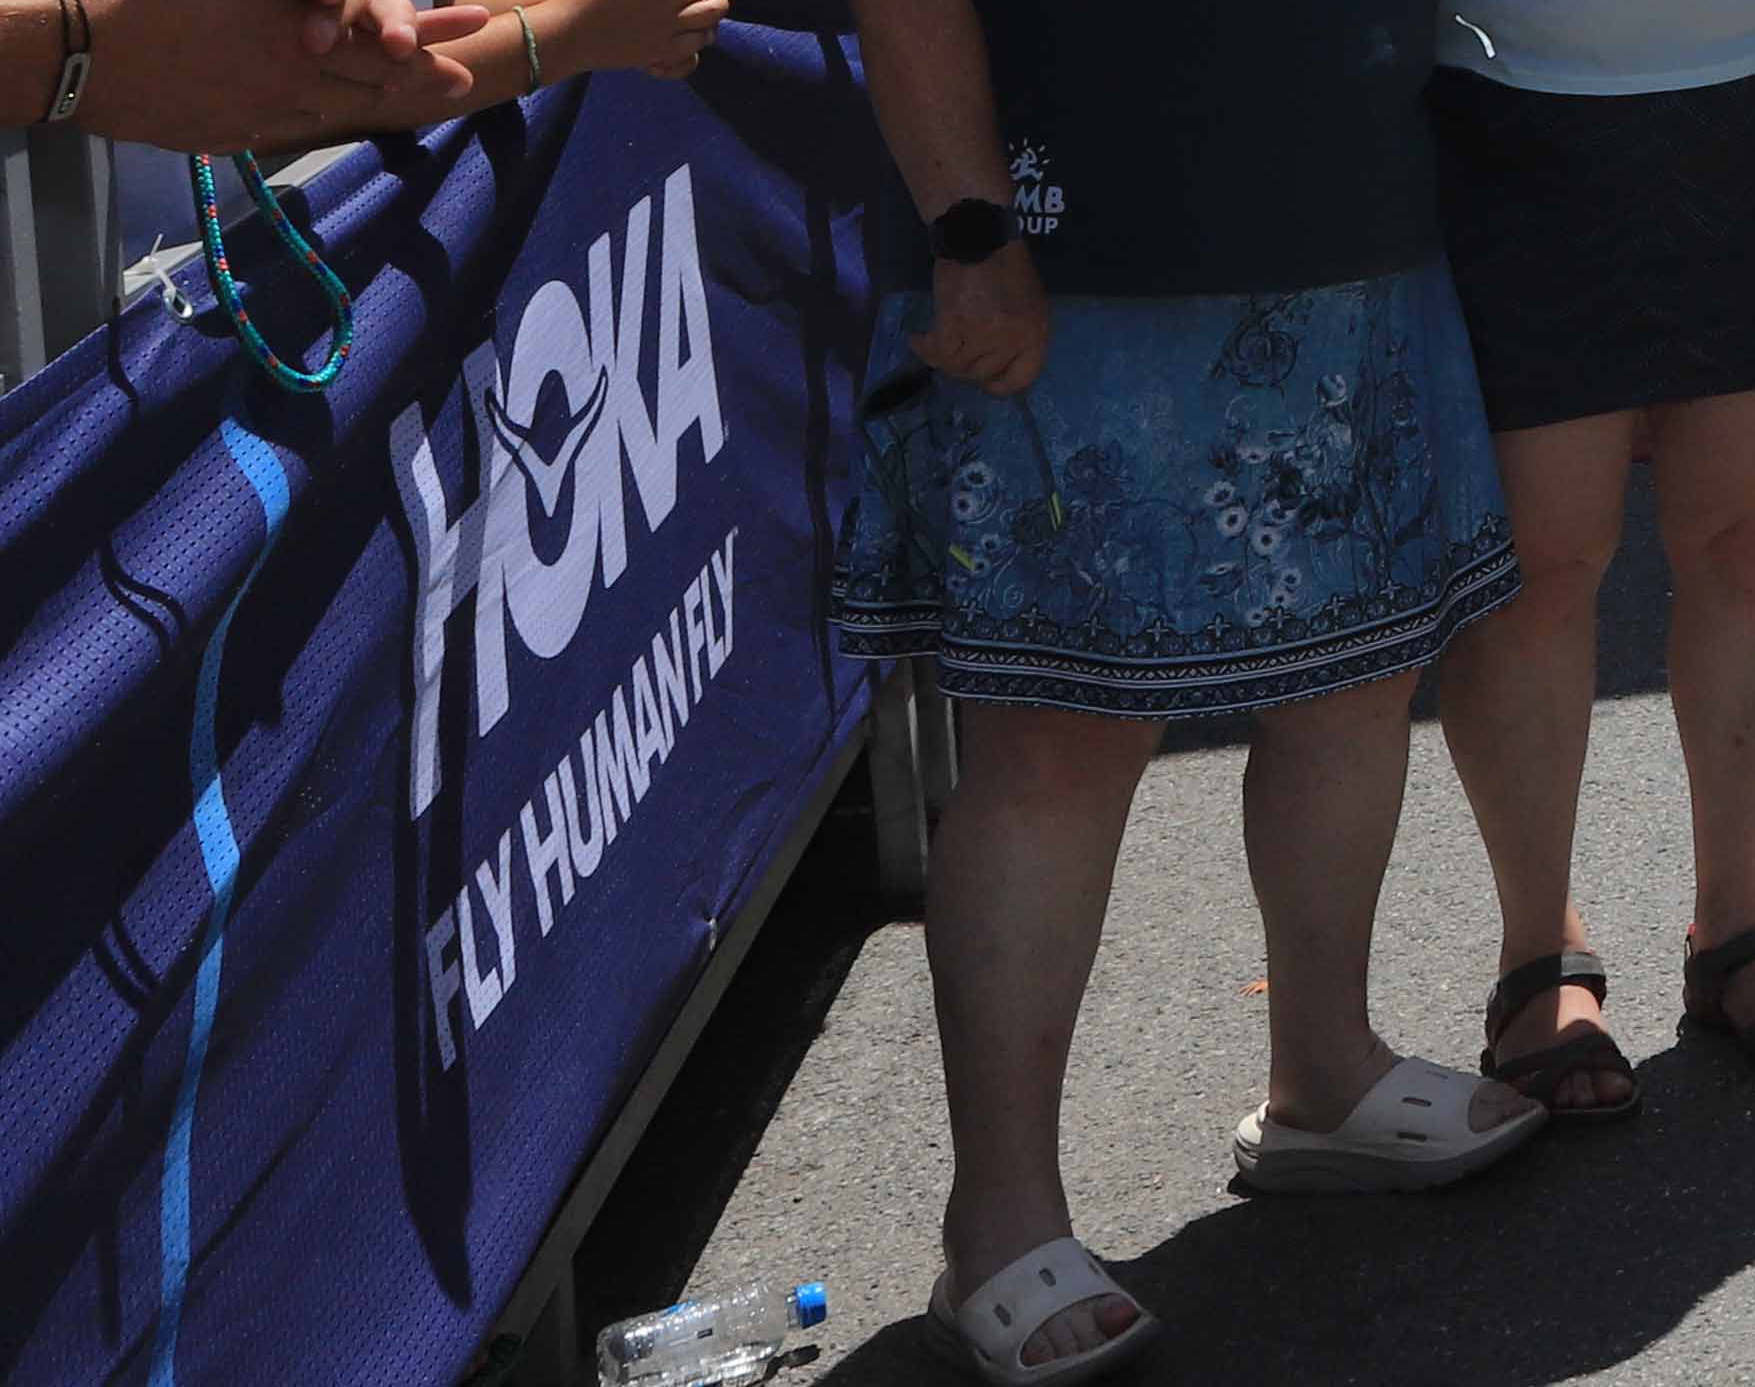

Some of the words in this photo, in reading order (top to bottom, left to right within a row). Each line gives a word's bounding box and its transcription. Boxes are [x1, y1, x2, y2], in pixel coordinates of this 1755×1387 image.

[389, 163, 728, 821] HOKA
[427, 828, 521, 1073] FLY
[521, 627, 690, 938] HUMAN
[681, 527, 738, 709] FLY
